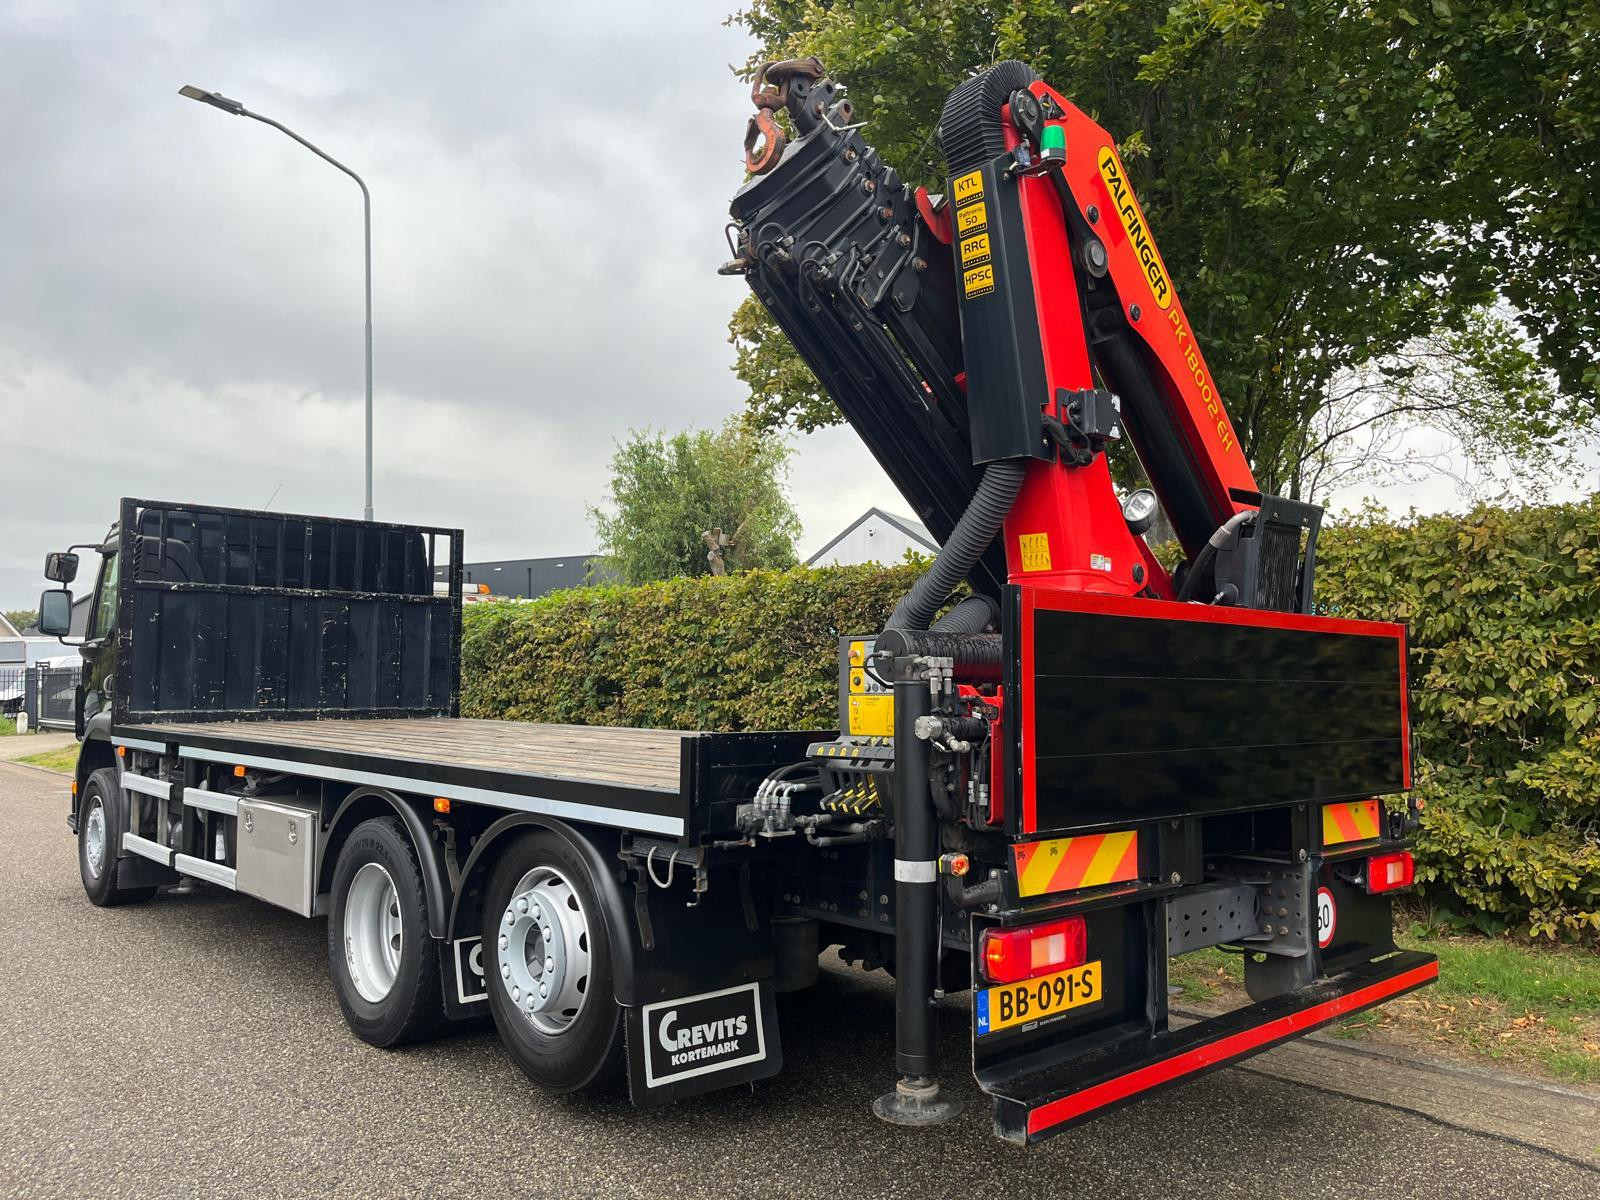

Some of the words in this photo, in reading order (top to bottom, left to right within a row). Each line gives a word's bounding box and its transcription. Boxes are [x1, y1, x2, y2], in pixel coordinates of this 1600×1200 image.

[958, 177, 978, 192] KTL
[959, 206, 984, 219] Paltronic
[965, 216, 978, 227] 50
[1101, 155, 1167, 302] PALFINGER
[963, 239, 986, 253] RRC
[965, 268, 992, 285] HPSC
[1168, 309, 1187, 345] PK
[1000, 969, 1093, 1022] BB-091-S
[978, 1017, 988, 1027] NL
[658, 1010, 748, 1052] CREVITS
[671, 1039, 740, 1066] KORTEMARK
